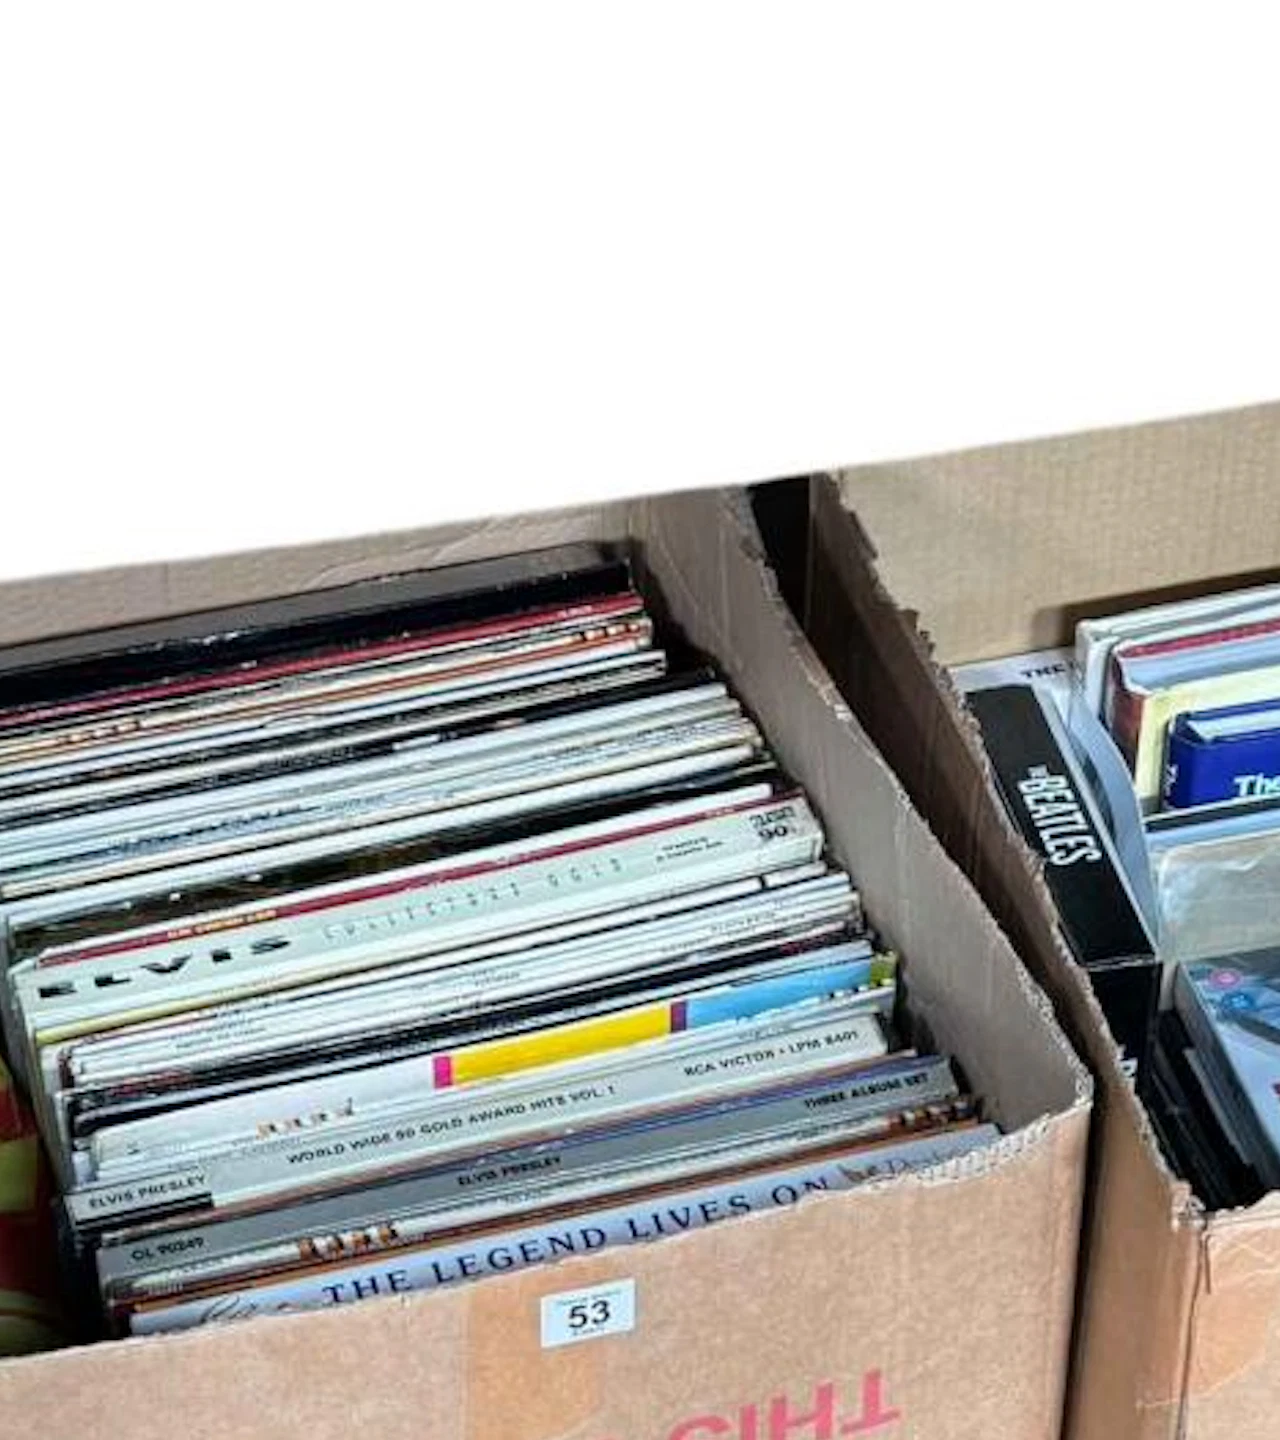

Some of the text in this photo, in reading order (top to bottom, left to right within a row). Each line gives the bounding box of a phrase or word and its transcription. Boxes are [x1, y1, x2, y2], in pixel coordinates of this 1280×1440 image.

[1017, 773, 1102, 867] BEATLES
[38, 935, 291, 998] ELVIS
[286, 1143, 345, 1165] WORLD
[349, 1132, 391, 1151] WIDE
[420, 1116, 464, 1135] GOLD
[468, 1104, 526, 1125] AWARD
[529, 1094, 567, 1113] HITS
[683, 1061, 717, 1078] RCA
[720, 1048, 776, 1070] VICTOR
[458, 1166, 498, 1187] ELVIS
[501, 1154, 562, 1177] PRESLEY
[851, 1077, 903, 1098] ALBUM
[89, 1173, 207, 1210] ELVIS PRESLEY
[321, 1176, 829, 1304] THE LEGEND LIVES ON
[567, 1299, 611, 1329] 53
